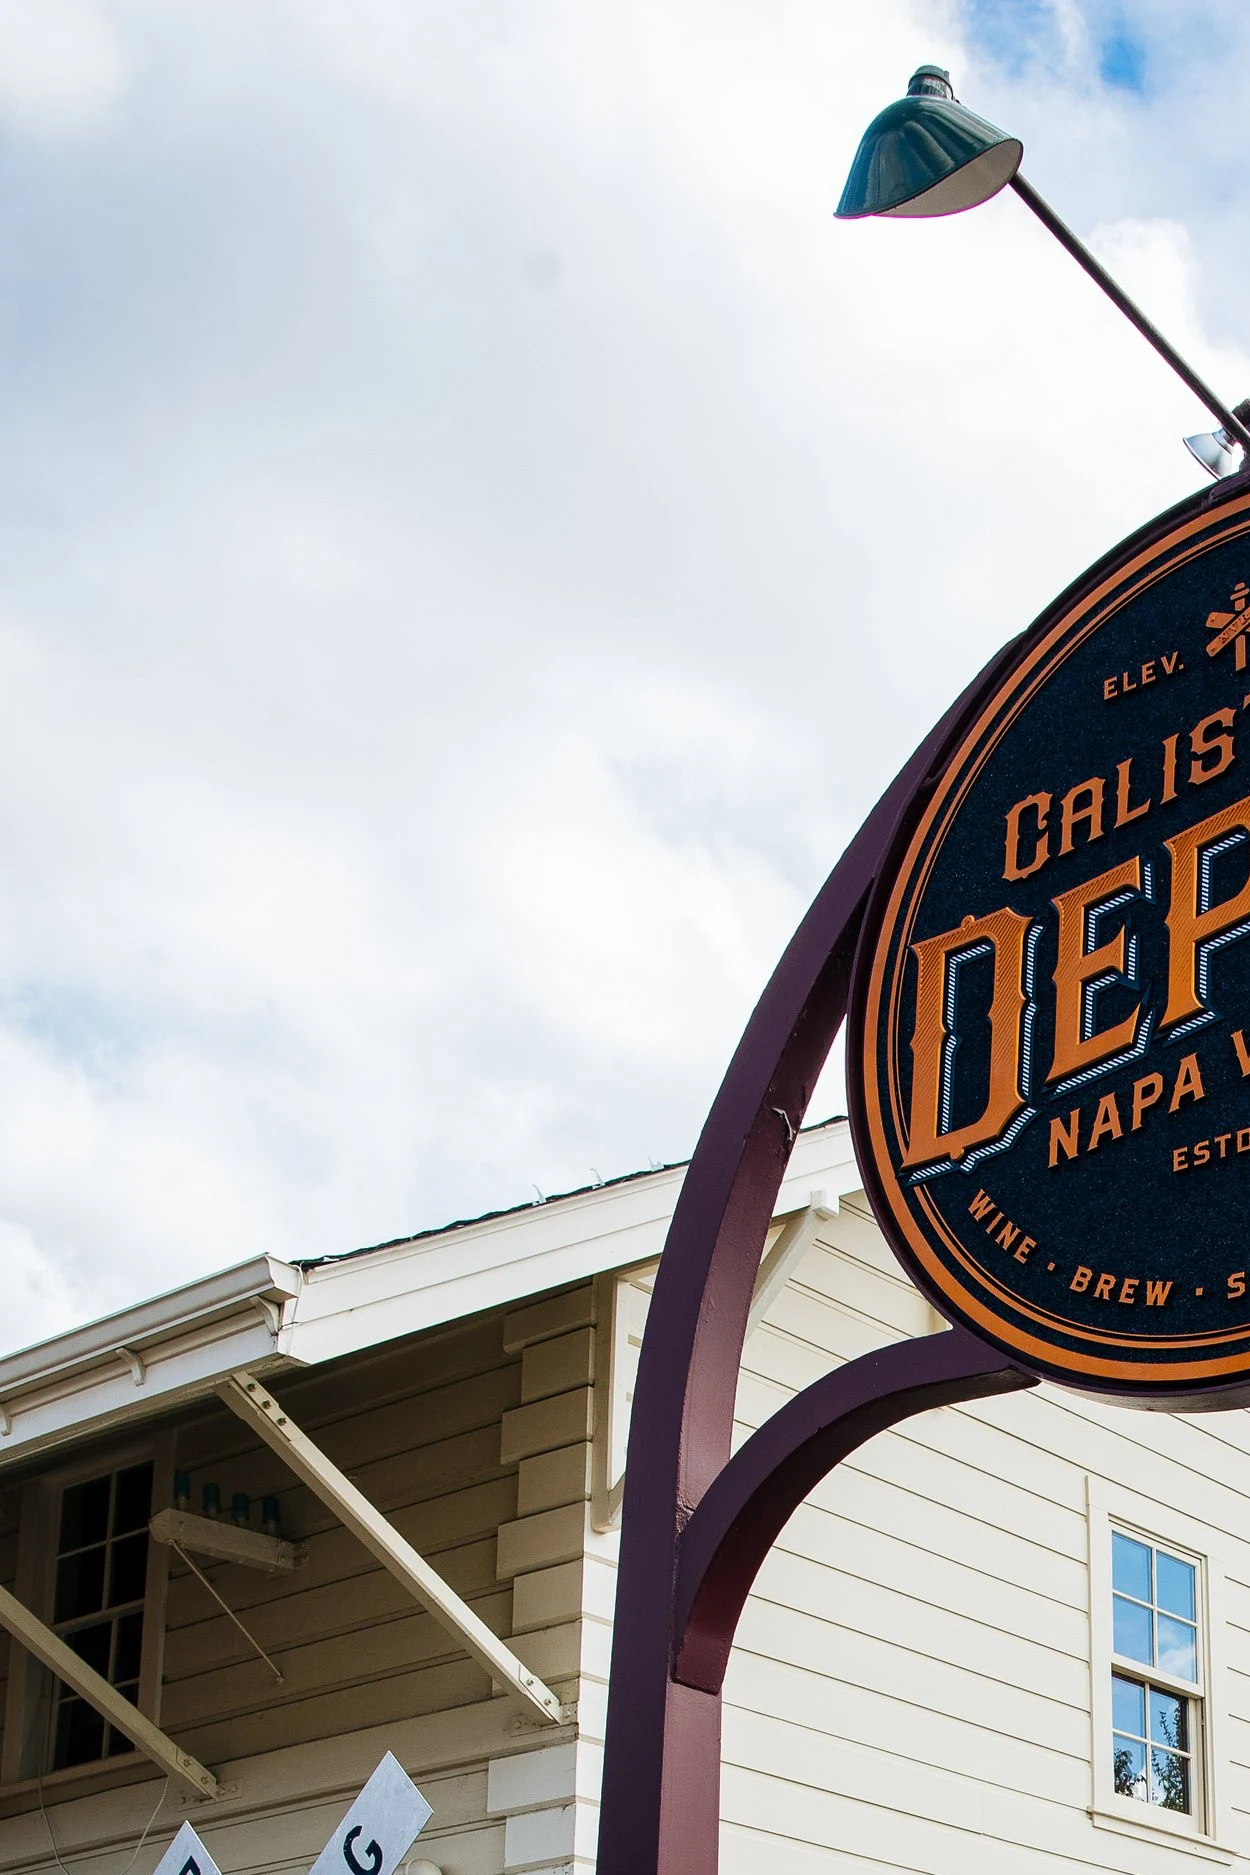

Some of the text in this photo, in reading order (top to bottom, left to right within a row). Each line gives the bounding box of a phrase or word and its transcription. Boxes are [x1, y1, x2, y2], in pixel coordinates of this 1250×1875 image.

[1103, 651, 1185, 701] ELEV.
[1047, 1052, 1206, 1169] NAPA
[968, 1187, 1038, 1265] WINE
[1069, 1264, 1178, 1308] BREW
